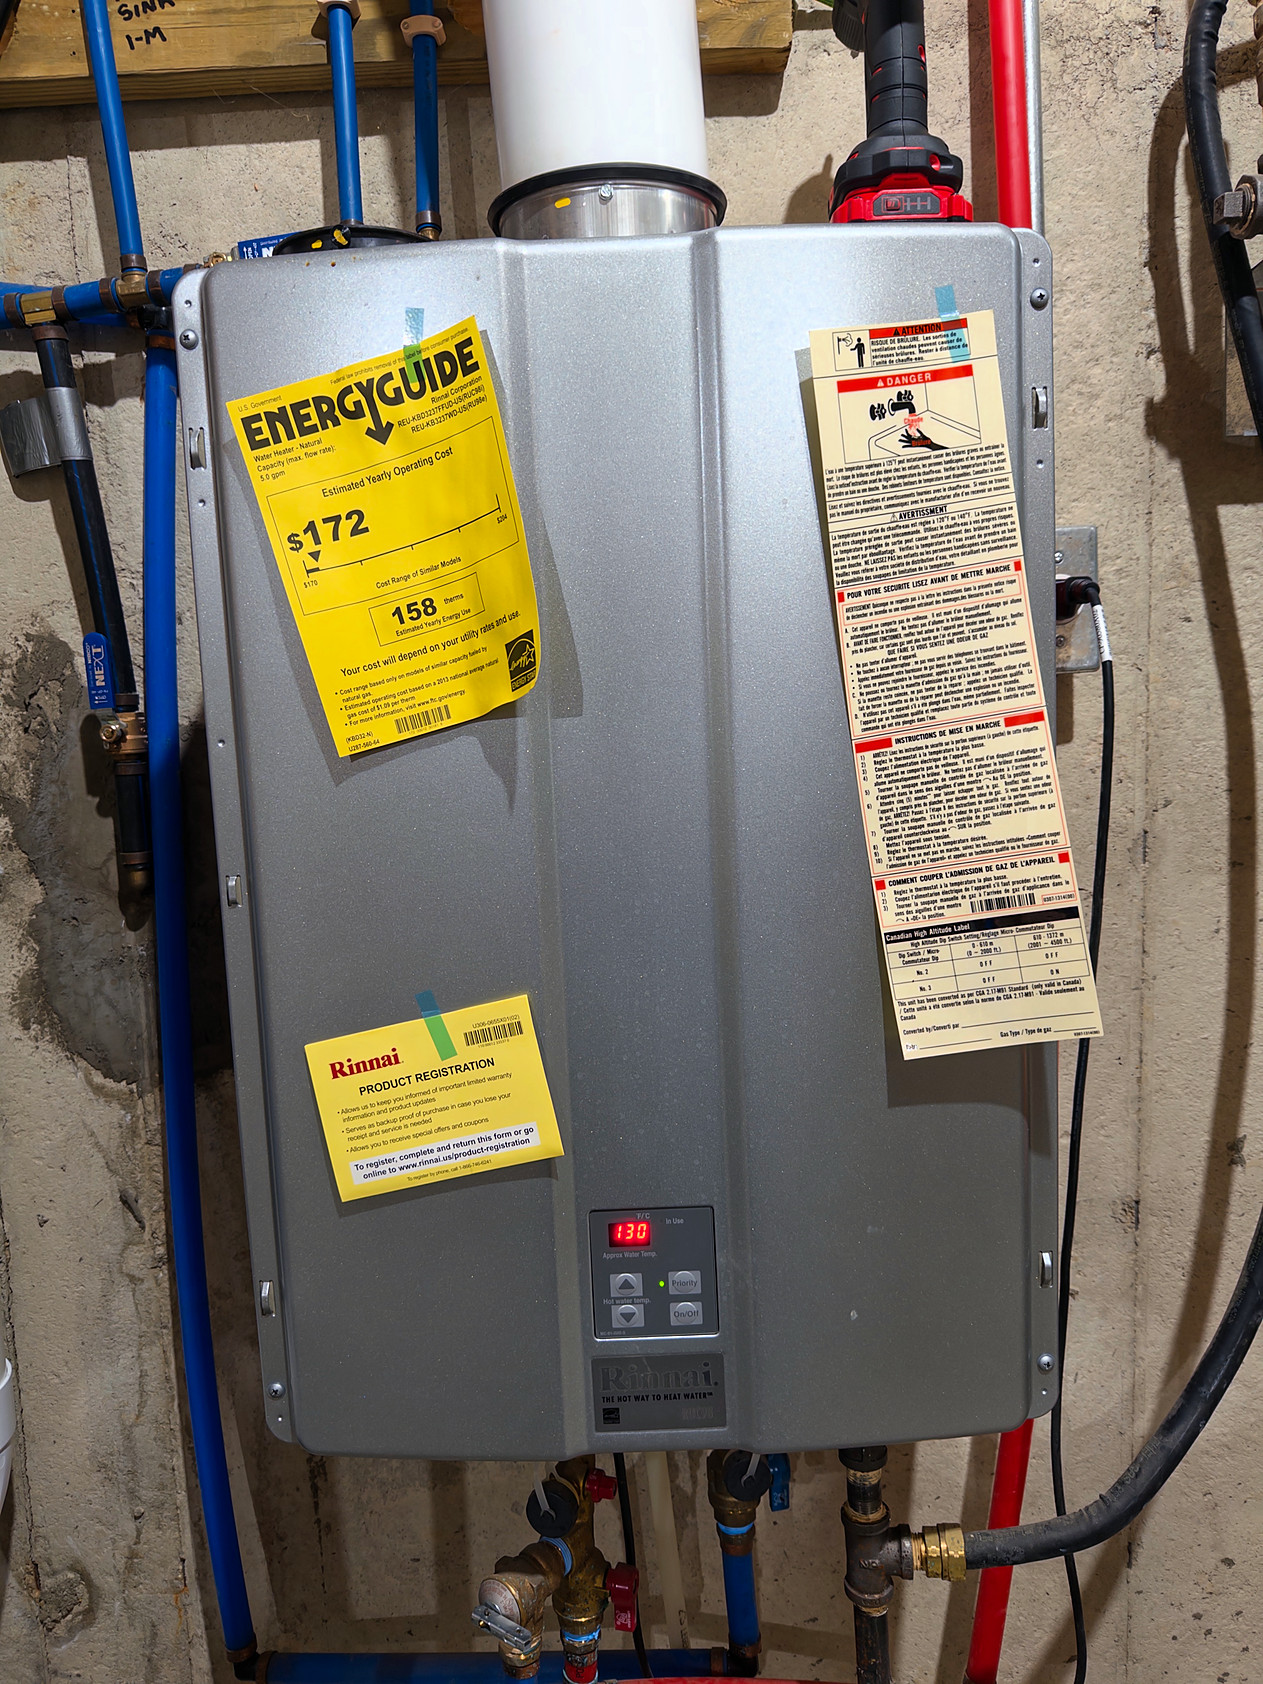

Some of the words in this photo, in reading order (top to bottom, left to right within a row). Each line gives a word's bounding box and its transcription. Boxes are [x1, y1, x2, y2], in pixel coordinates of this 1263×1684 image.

[902, 322, 942, 335] ATTENTION
[241, 336, 480, 451] ENERGYGUIDE
[430, 390, 450, 405] Rinnai
[449, 375, 483, 396] Corporation
[886, 372, 932, 386] DANGER
[237, 404, 249, 413] U.S.
[250, 394, 283, 409] Government
[253, 452, 273, 463] Water
[272, 446, 294, 458] Heater
[298, 437, 323, 450] Natural
[256, 460, 285, 473] Capacity
[285, 455, 303, 466] (max.
[304, 450, 318, 459] flow
[318, 444, 335, 455] rate):
[259, 473, 271, 482] 5.0
[270, 470, 286, 481] gpm
[321, 477, 366, 498] Estimated
[365, 470, 392, 485] Yearly
[393, 456, 434, 477] Operating
[434, 446, 454, 461] Cost
[898, 505, 948, 520] AVERTISSMENT
[286, 509, 370, 554] $172
[303, 579, 319, 589] $170
[375, 579, 391, 589] Cost
[390, 573, 411, 585] Range
[411, 569, 419, 578] of
[418, 564, 440, 576] Similar
[440, 556, 462, 569] Models
[846, 590, 863, 600] POUR
[863, 586, 882, 597] VOTRE
[883, 581, 911, 594] SECURITE
[911, 578, 929, 588] LISEZ
[930, 574, 949, 585] AVANT
[950, 573, 959, 582] DE
[960, 568, 984, 580] METTRE
[985, 564, 1011, 575] MARCHE
[391, 597, 438, 625] 158
[443, 593, 464, 605] therms
[395, 622, 424, 637] Estimated
[423, 618, 442, 628] Yearly
[441, 612, 461, 623] Energy
[460, 608, 472, 616] Use
[340, 666, 361, 677] Your
[362, 660, 382, 672] cost
[381, 654, 397, 666] will
[397, 645, 428, 662] depend
[429, 643, 441, 653] on
[440, 636, 459, 651] your
[459, 629, 479, 643] utility
[479, 622, 496, 635] rates
[495, 614, 508, 627] and
[507, 610, 521, 622] use.
[92, 645, 105, 686] NEXT
[894, 731, 938, 745] INSTRUCTIONS
[938, 729, 947, 738] DE
[948, 726, 964, 736] MISE
[964, 725, 974, 733] EN
[975, 720, 1002, 731] MARCHE
[888, 876, 918, 887] COMMENT
[919, 872, 944, 883] COUPER
[944, 866, 984, 879] L'ADMISSION
[984, 864, 994, 873] DE
[995, 862, 1009, 871] GAZ
[1009, 861, 1019, 869] DE
[1020, 856, 1056, 868] L'APPAREIL
[885, 932, 913, 942] Canadian
[913, 929, 928, 938] High
[929, 926, 952, 936] Altitude
[953, 923, 971, 932] Label
[329, 1047, 401, 1080] Rinnai
[358, 1074, 412, 1096] PRODUCT
[414, 1057, 495, 1083] REGISTRATION
[340, 1106, 361, 1115] Allows
[376, 1098, 392, 1107] keep
[392, 1096, 405, 1105] you
[404, 1088, 432, 1100] informed
[431, 1086, 438, 1094] of
[438, 1081, 467, 1092] important
[466, 1076, 487, 1086] limited
[486, 1072, 513, 1082] warranty
[342, 1111, 376, 1123] information
[376, 1107, 389, 1116] and
[388, 1102, 412, 1114] product
[411, 1097, 437, 1108] updates
[345, 1124, 367, 1134] Serves
[375, 1117, 399, 1128] backup
[398, 1112, 415, 1123] proof
[414, 1110, 422, 1118] of
[422, 1105, 450, 1118] purchase
[456, 1100, 472, 1109] case
[471, 1098, 484, 1107] you
[497, 1092, 512, 1102] your
[347, 1132, 368, 1142] receipt
[368, 1129, 381, 1138] and
[380, 1125, 403, 1135] service
[409, 1116, 433, 1128] needed
[349, 1144, 370, 1154] Allows
[369, 1141, 382, 1150] you
[388, 1134, 412, 1144] receive
[411, 1128, 434, 1139] special
[433, 1125, 451, 1134] offers
[451, 1121, 464, 1130] and
[463, 1117, 490, 1128] coupons
[353, 1163, 365, 1171] To
[365, 1156, 398, 1169] register,
[398, 1148, 435, 1162] complete
[436, 1142, 452, 1153] and
[452, 1139, 476, 1149] return
[476, 1134, 493, 1144] this
[493, 1131, 513, 1140] form
[523, 1127, 534, 1136] go
[362, 1169, 387, 1180] online
[397, 1138, 531, 1172] www.rinnai.us/product-registration
[616, 1223, 646, 1240] 130
[672, 1279, 698, 1288] Priority
[674, 1310, 699, 1318] On/Off
